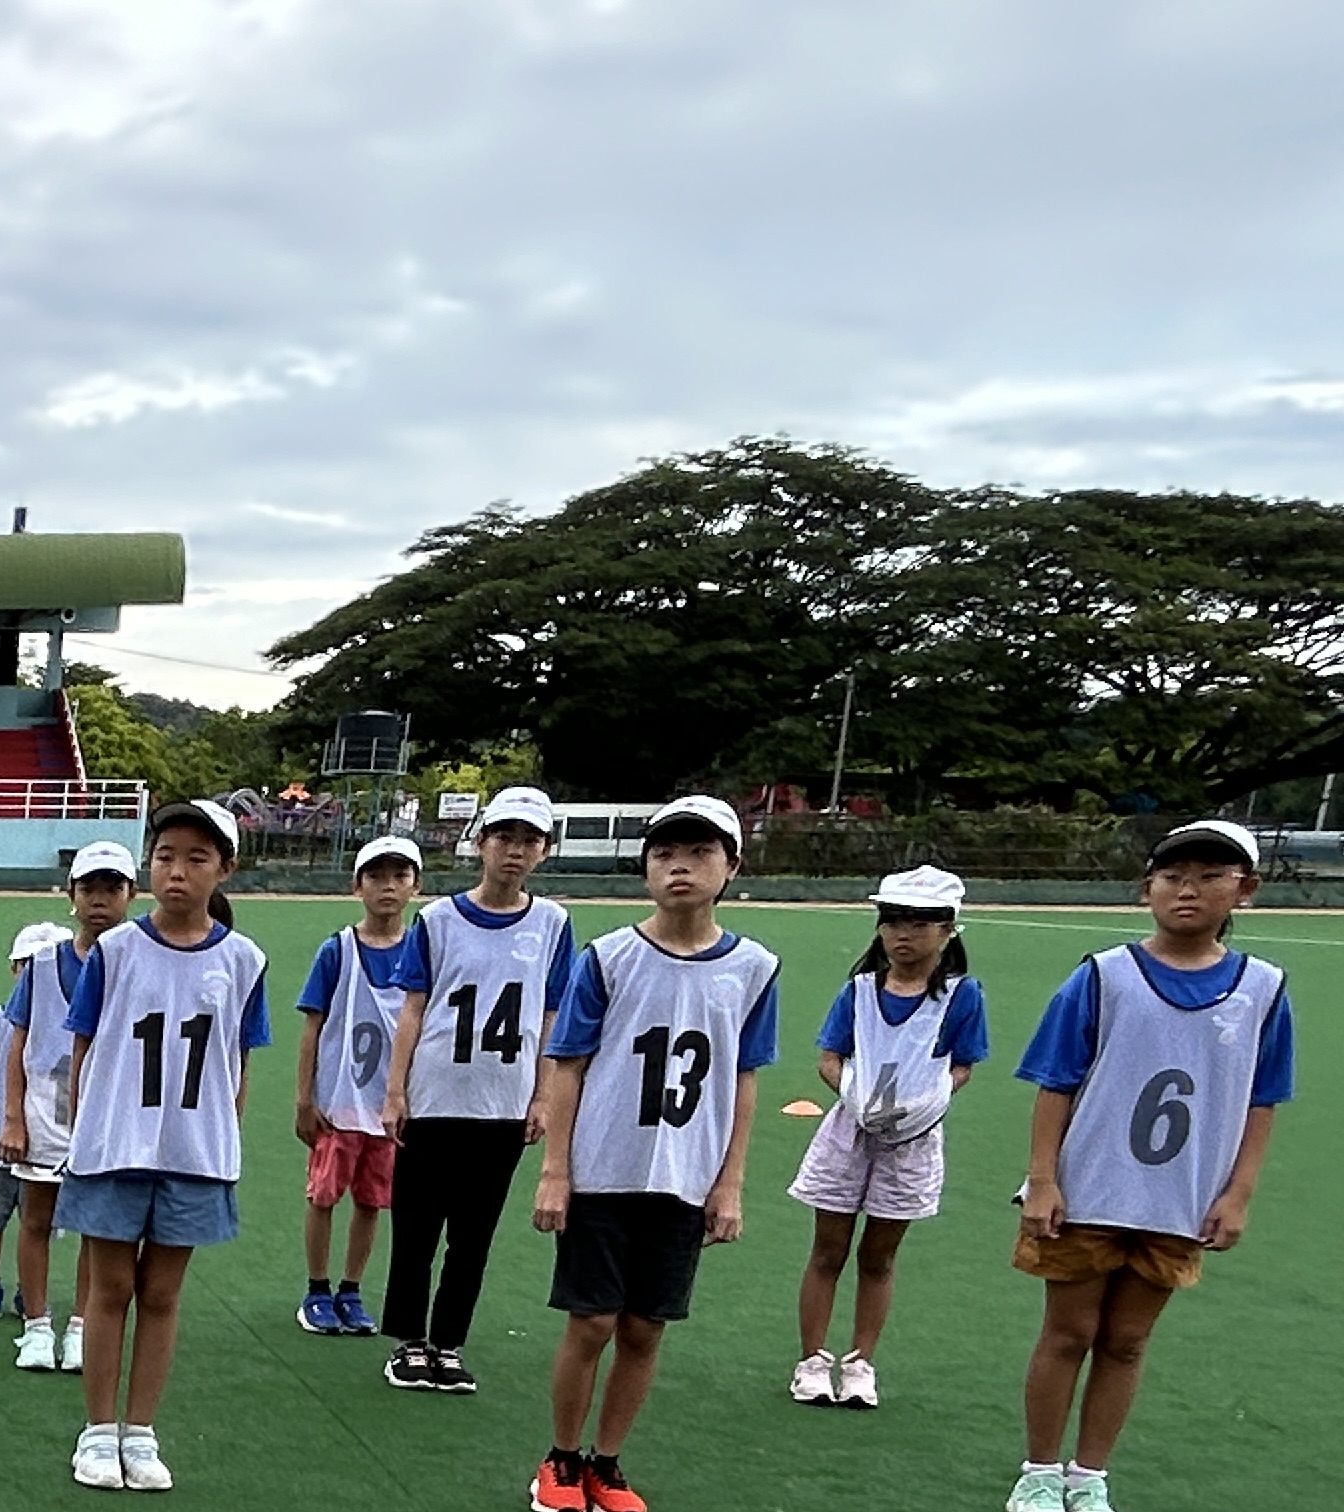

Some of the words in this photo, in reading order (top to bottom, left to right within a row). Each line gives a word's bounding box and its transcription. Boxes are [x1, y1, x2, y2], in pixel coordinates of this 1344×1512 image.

[132, 1012, 214, 1110] 11
[351, 1021, 383, 1089] 9
[448, 982, 524, 1064] 14
[632, 1026, 711, 1128] 13
[1129, 1068, 1194, 1166] 6
